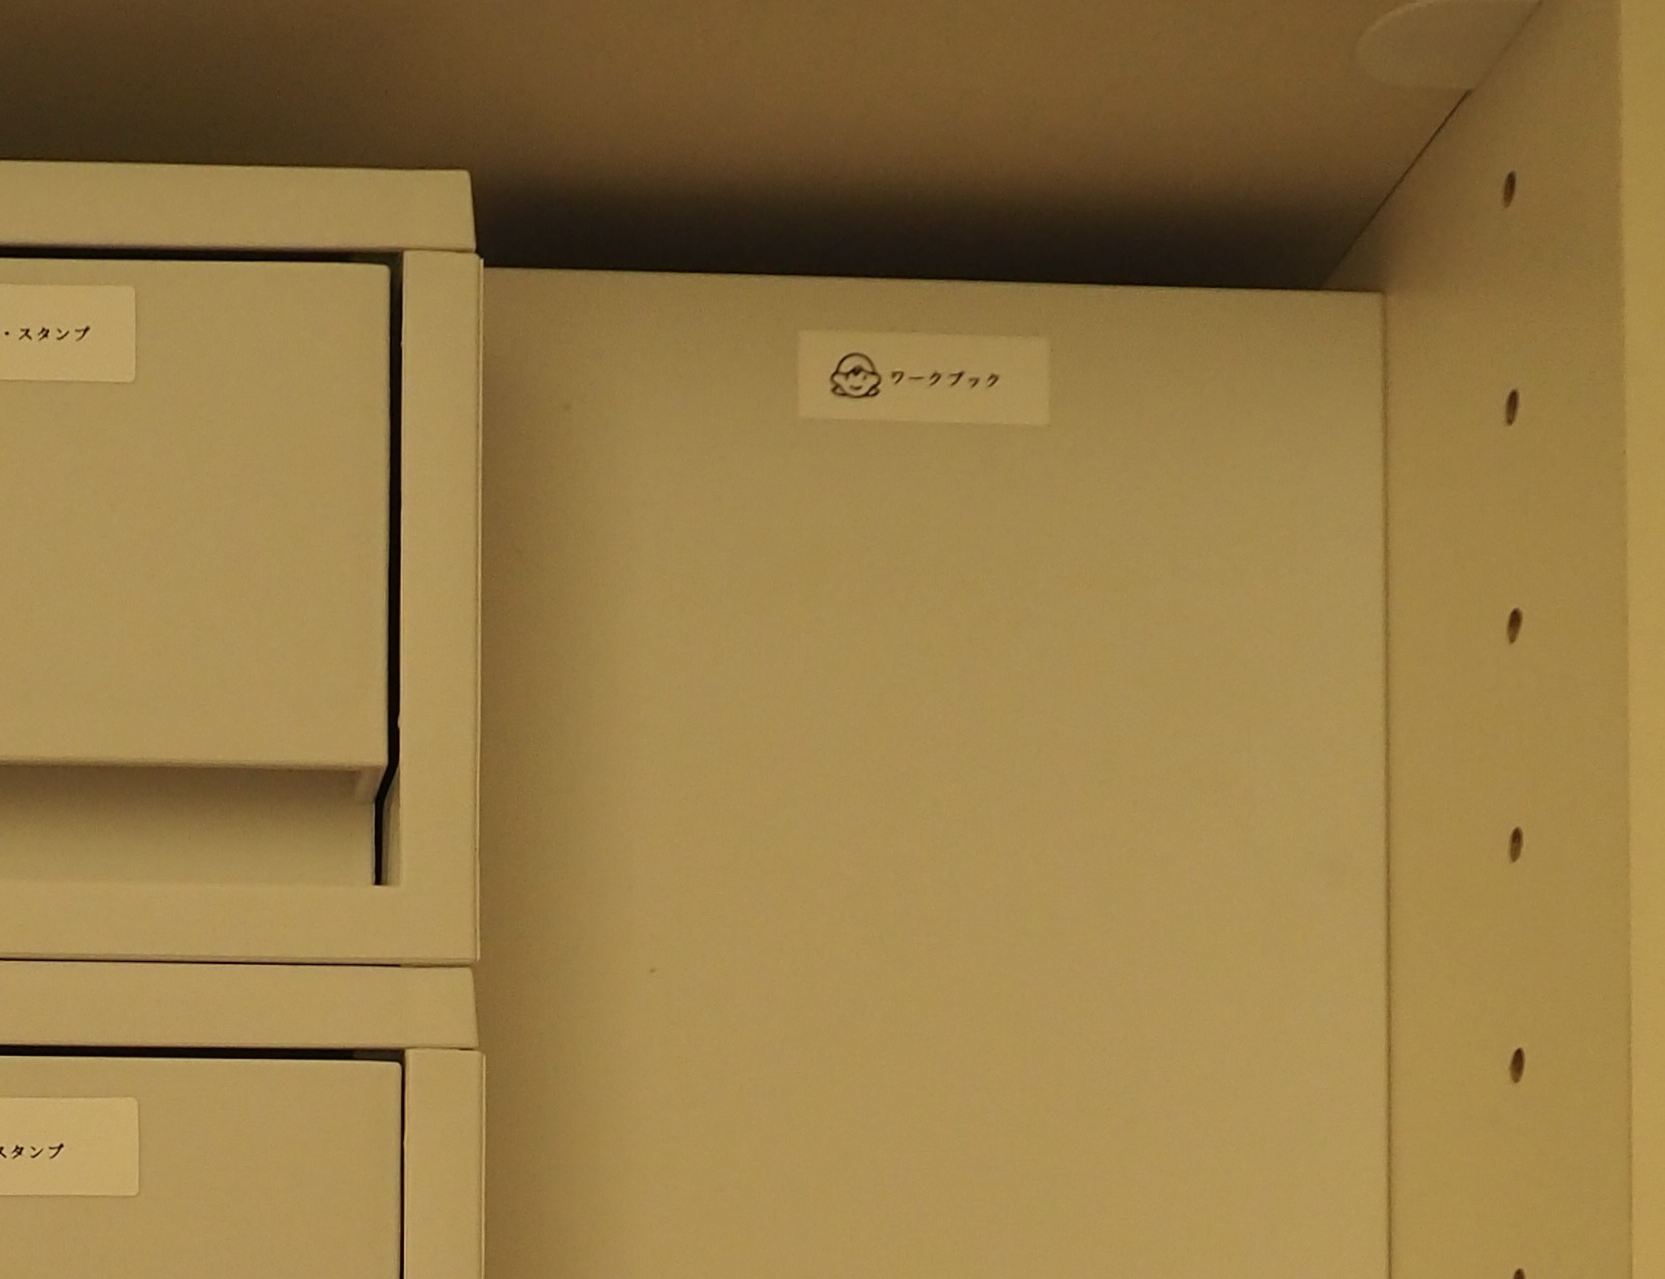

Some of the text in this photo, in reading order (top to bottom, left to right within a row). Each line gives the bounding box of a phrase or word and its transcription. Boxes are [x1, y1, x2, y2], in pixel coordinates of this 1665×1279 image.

[891, 371, 1000, 388] ワークブック
